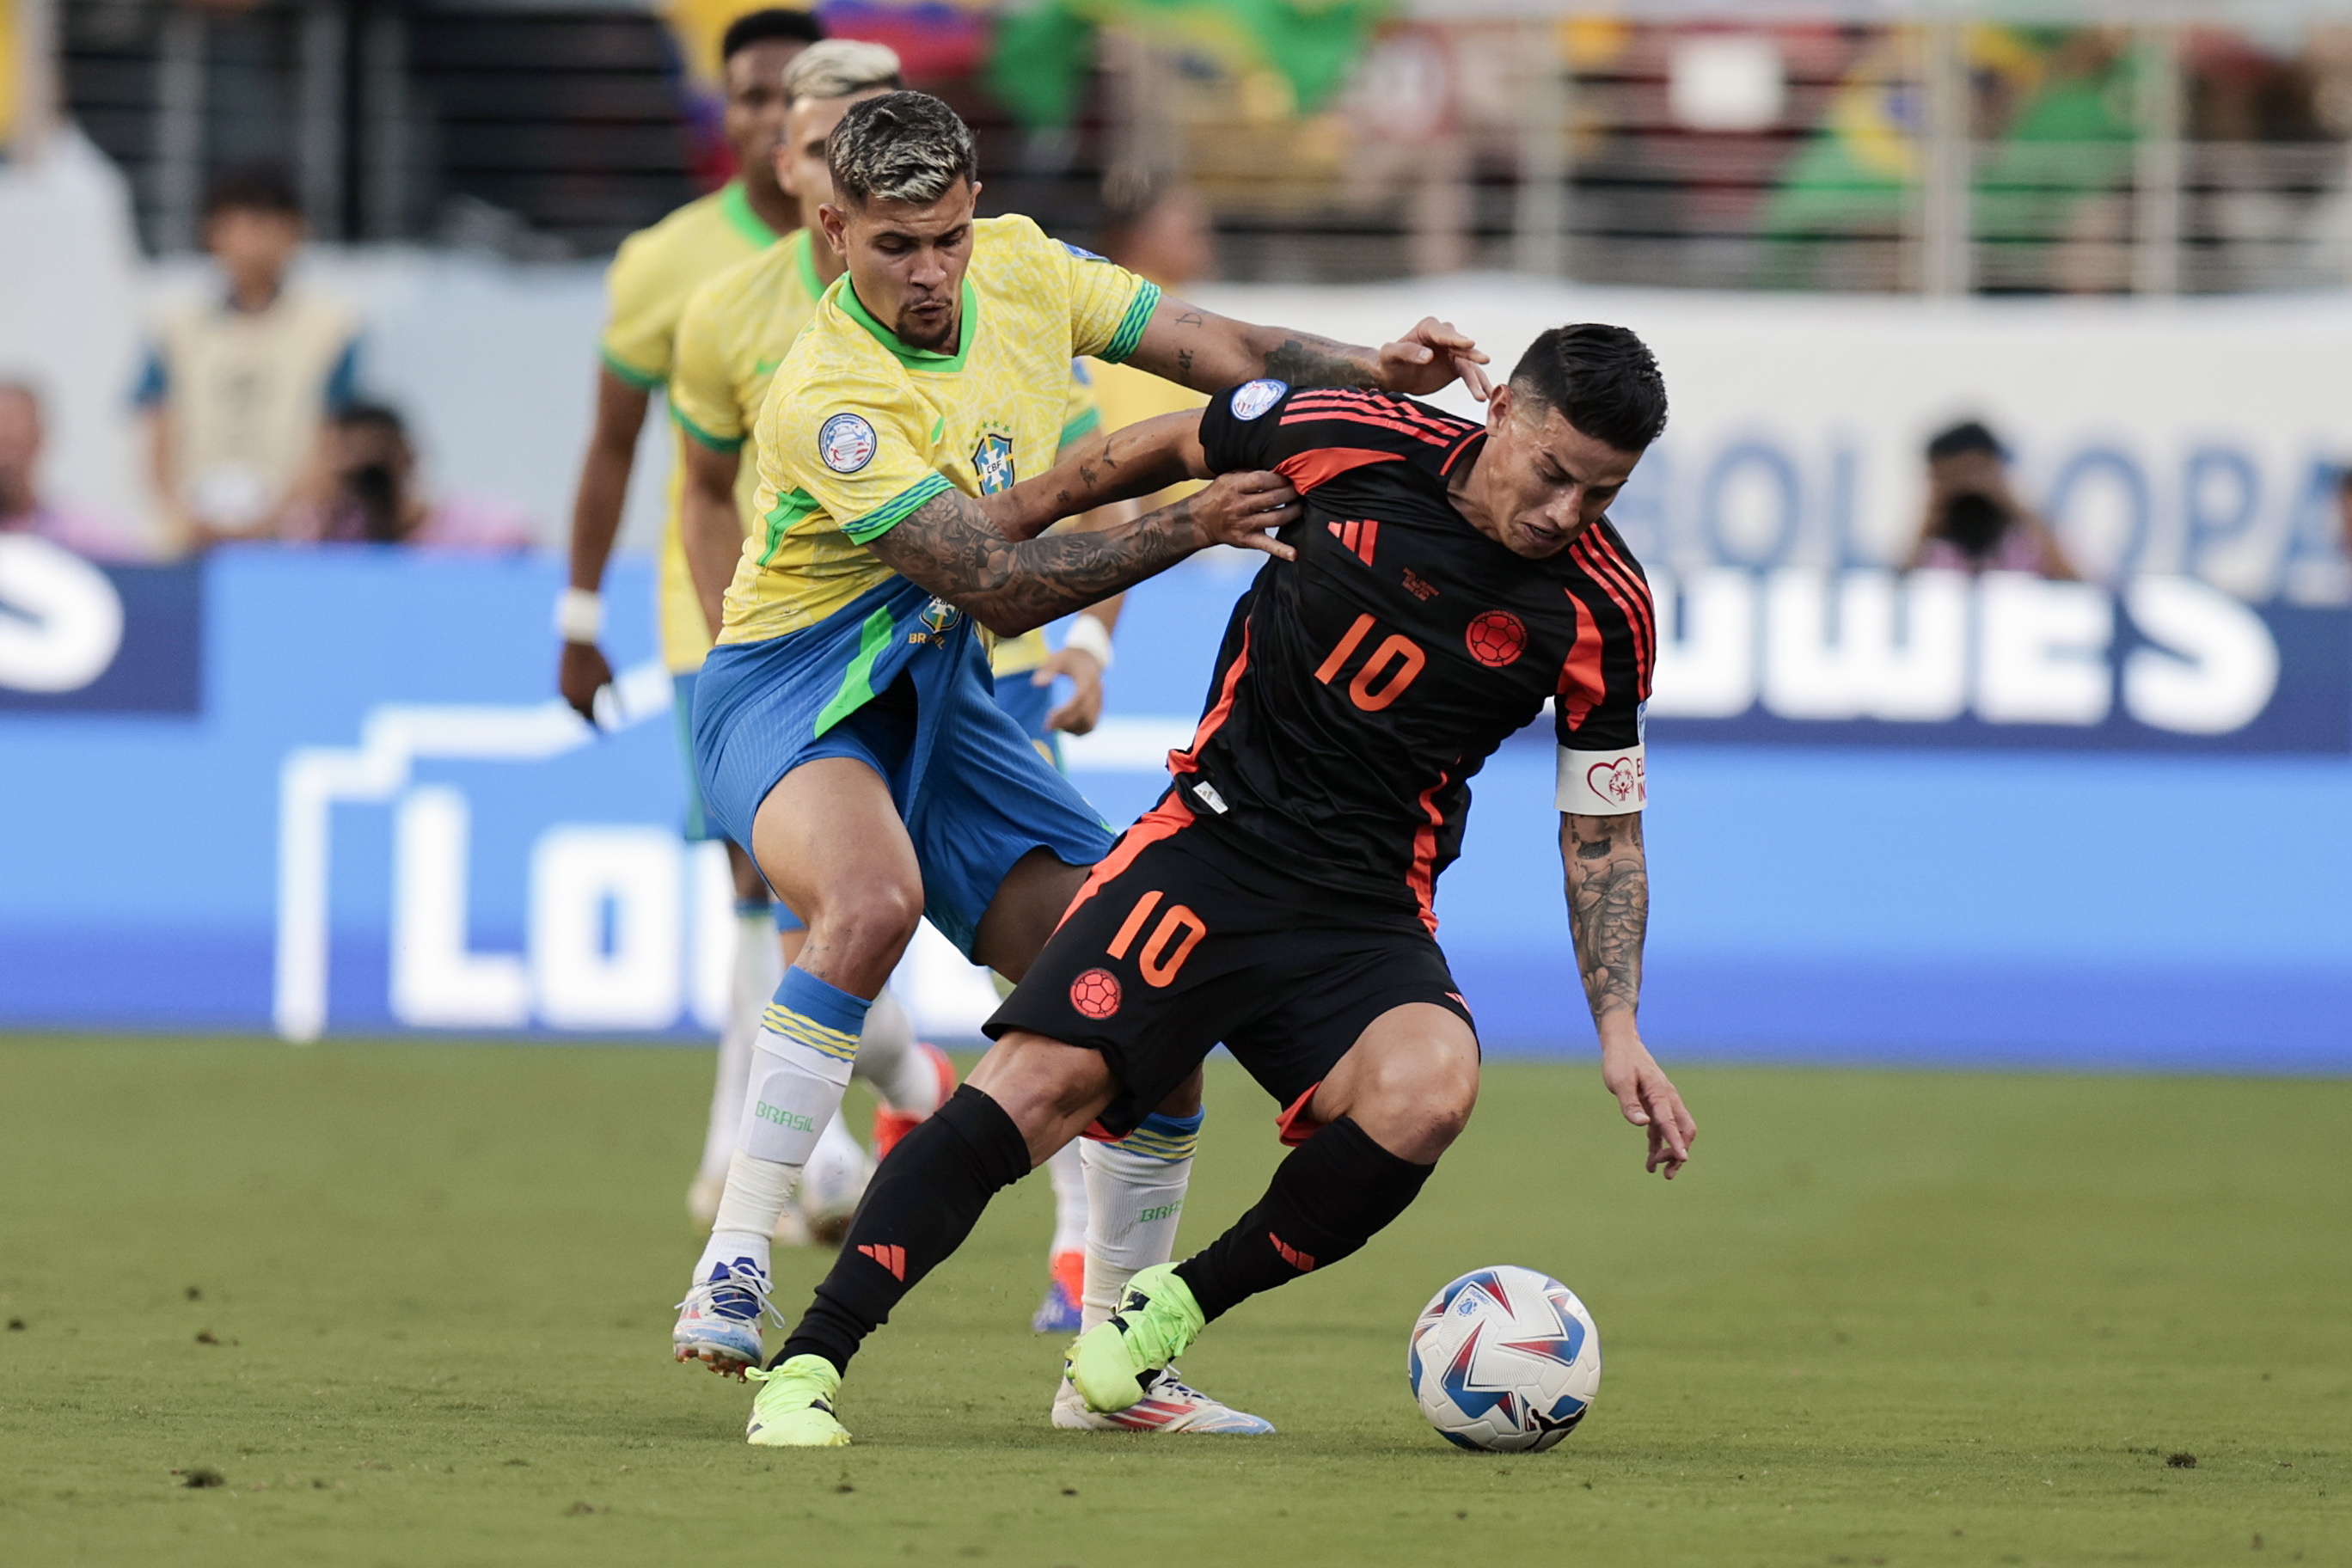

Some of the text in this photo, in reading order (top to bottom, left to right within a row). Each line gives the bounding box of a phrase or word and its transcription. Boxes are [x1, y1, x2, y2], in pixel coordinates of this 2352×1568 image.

[986, 460, 1001, 475] CBF
[2049, 440, 2345, 597] OPA
[1314, 613, 1425, 712] 10
[1106, 890, 1207, 988] 10
[755, 1100, 814, 1133] BRASIL
[1139, 1198, 1185, 1222] BRA
